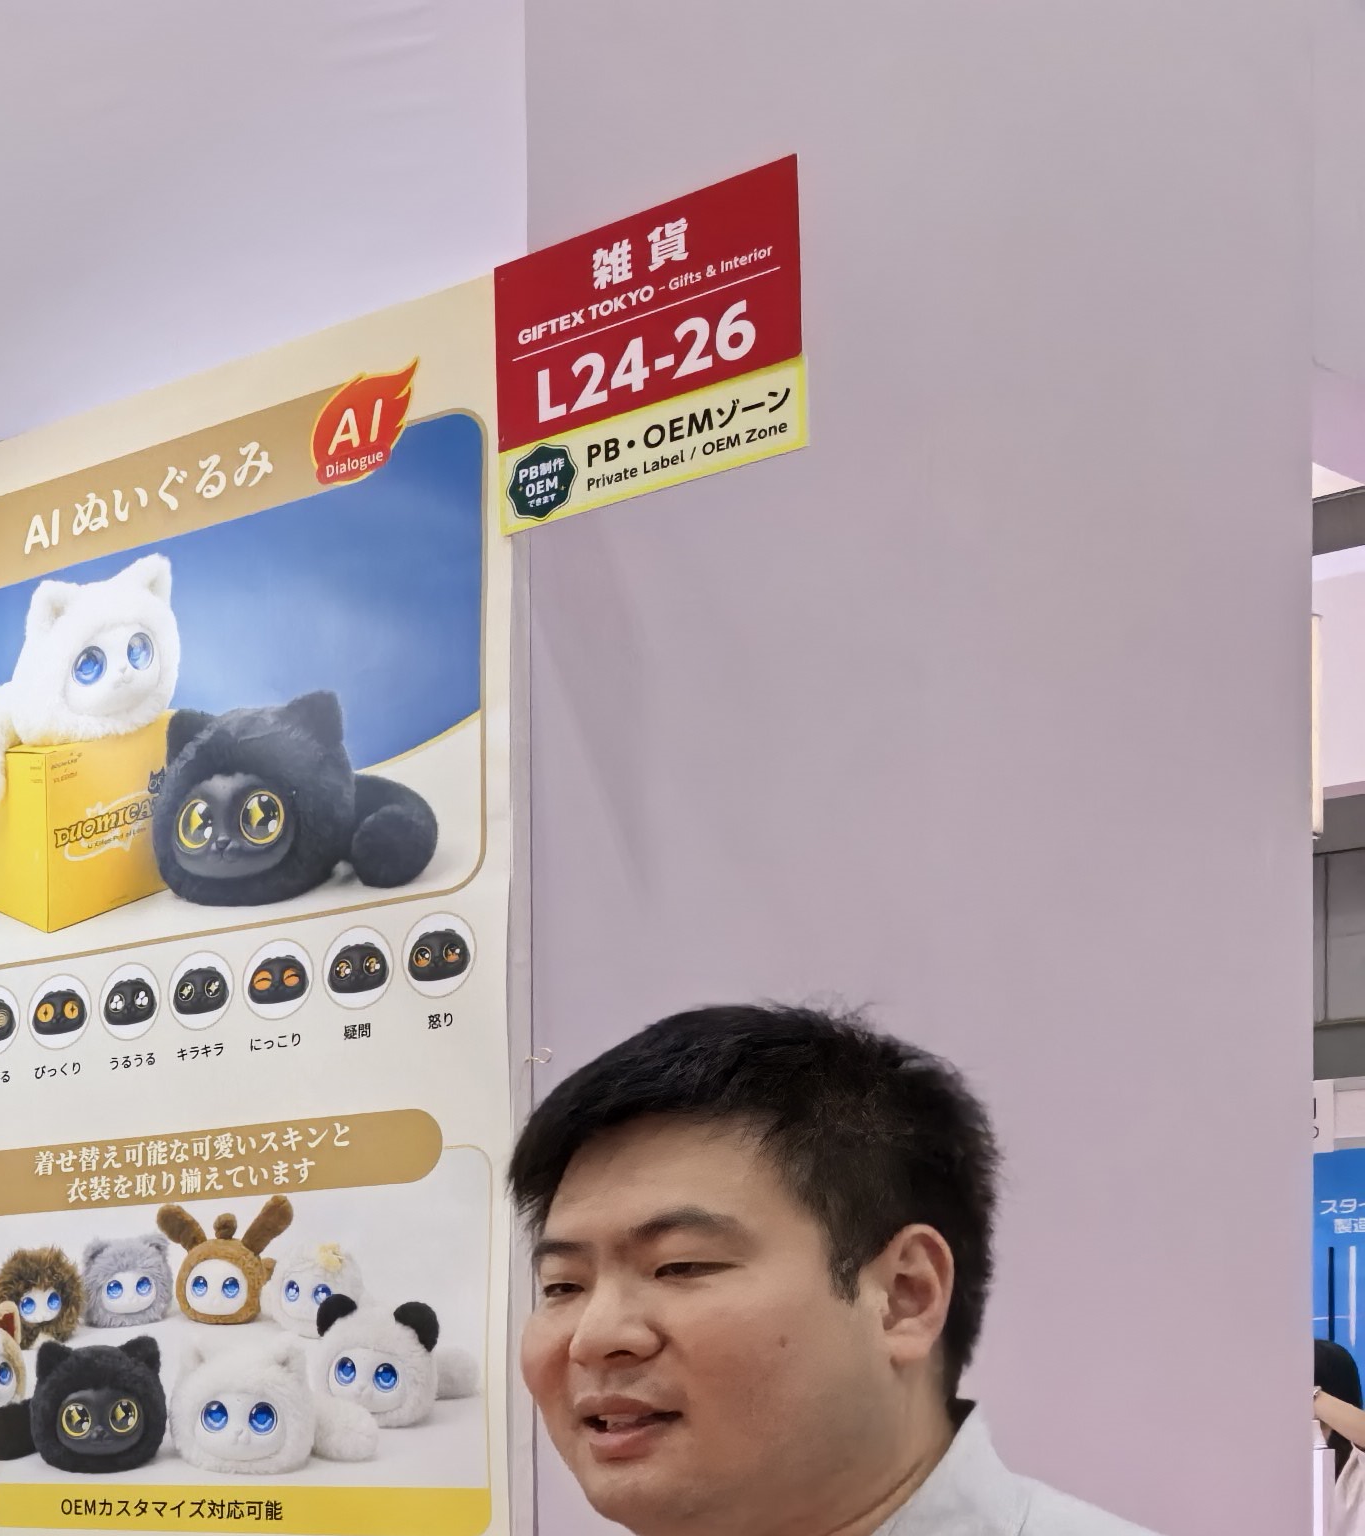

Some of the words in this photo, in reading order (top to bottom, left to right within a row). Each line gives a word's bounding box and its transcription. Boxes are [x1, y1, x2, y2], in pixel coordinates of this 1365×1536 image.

[592, 217, 688, 290] 雑貨
[518, 308, 585, 346] GIFTEX
[587, 285, 654, 319] TOKYO
[668, 269, 702, 292] Gifts
[706, 265, 716, 277] &
[720, 245, 773, 273] Interior
[537, 299, 757, 424] L24-26
[328, 398, 384, 456] AI
[325, 449, 384, 481] Dialogue
[587, 466, 638, 492] Private
[643, 450, 685, 475] Label
[702, 433, 741, 457] OEM
[745, 421, 788, 443] Zone
[24, 508, 60, 554] AI
[71, 441, 273, 536] ぬいぐるみ
[525, 476, 558, 497] OEM
[343, 1022, 372, 1042] 疑問
[427, 1012, 454, 1030] 怒り
[177, 1043, 224, 1061] キラキラ
[249, 1031, 302, 1052] にっこり
[34, 1062, 81, 1080] びっくり
[109, 1052, 156, 1070] うるうる
[34, 1122, 350, 1176] 着せ替え可能な可愛いスキンと
[66, 1158, 315, 1203] 衣装を取り揃えています
[60, 1498, 284, 1521] OEMカスタマイズ対応可能
